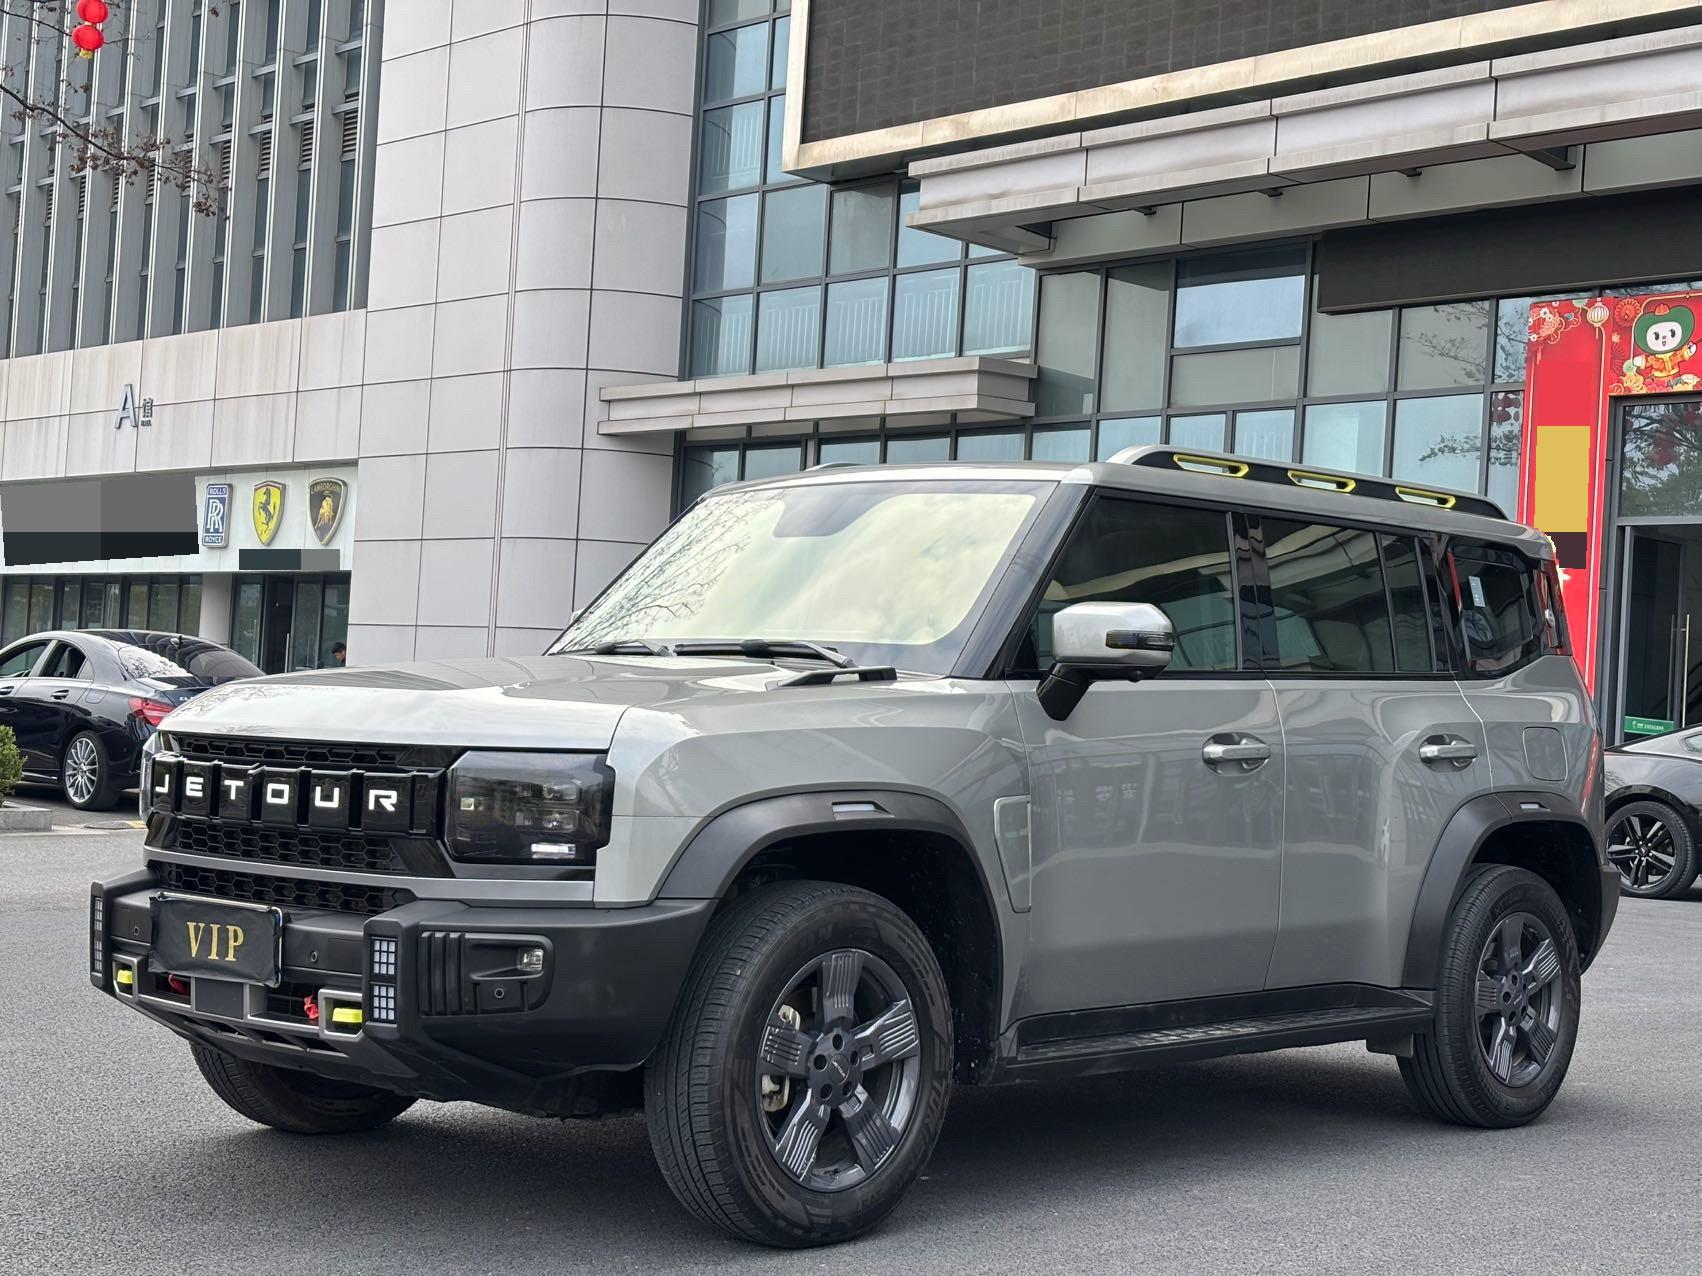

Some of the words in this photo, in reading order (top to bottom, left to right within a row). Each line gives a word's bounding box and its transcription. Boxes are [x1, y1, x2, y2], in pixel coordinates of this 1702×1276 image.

[209, 487, 226, 495] ROLLS
[155, 773, 398, 812] JETOUR
[186, 921, 244, 961] VIP
